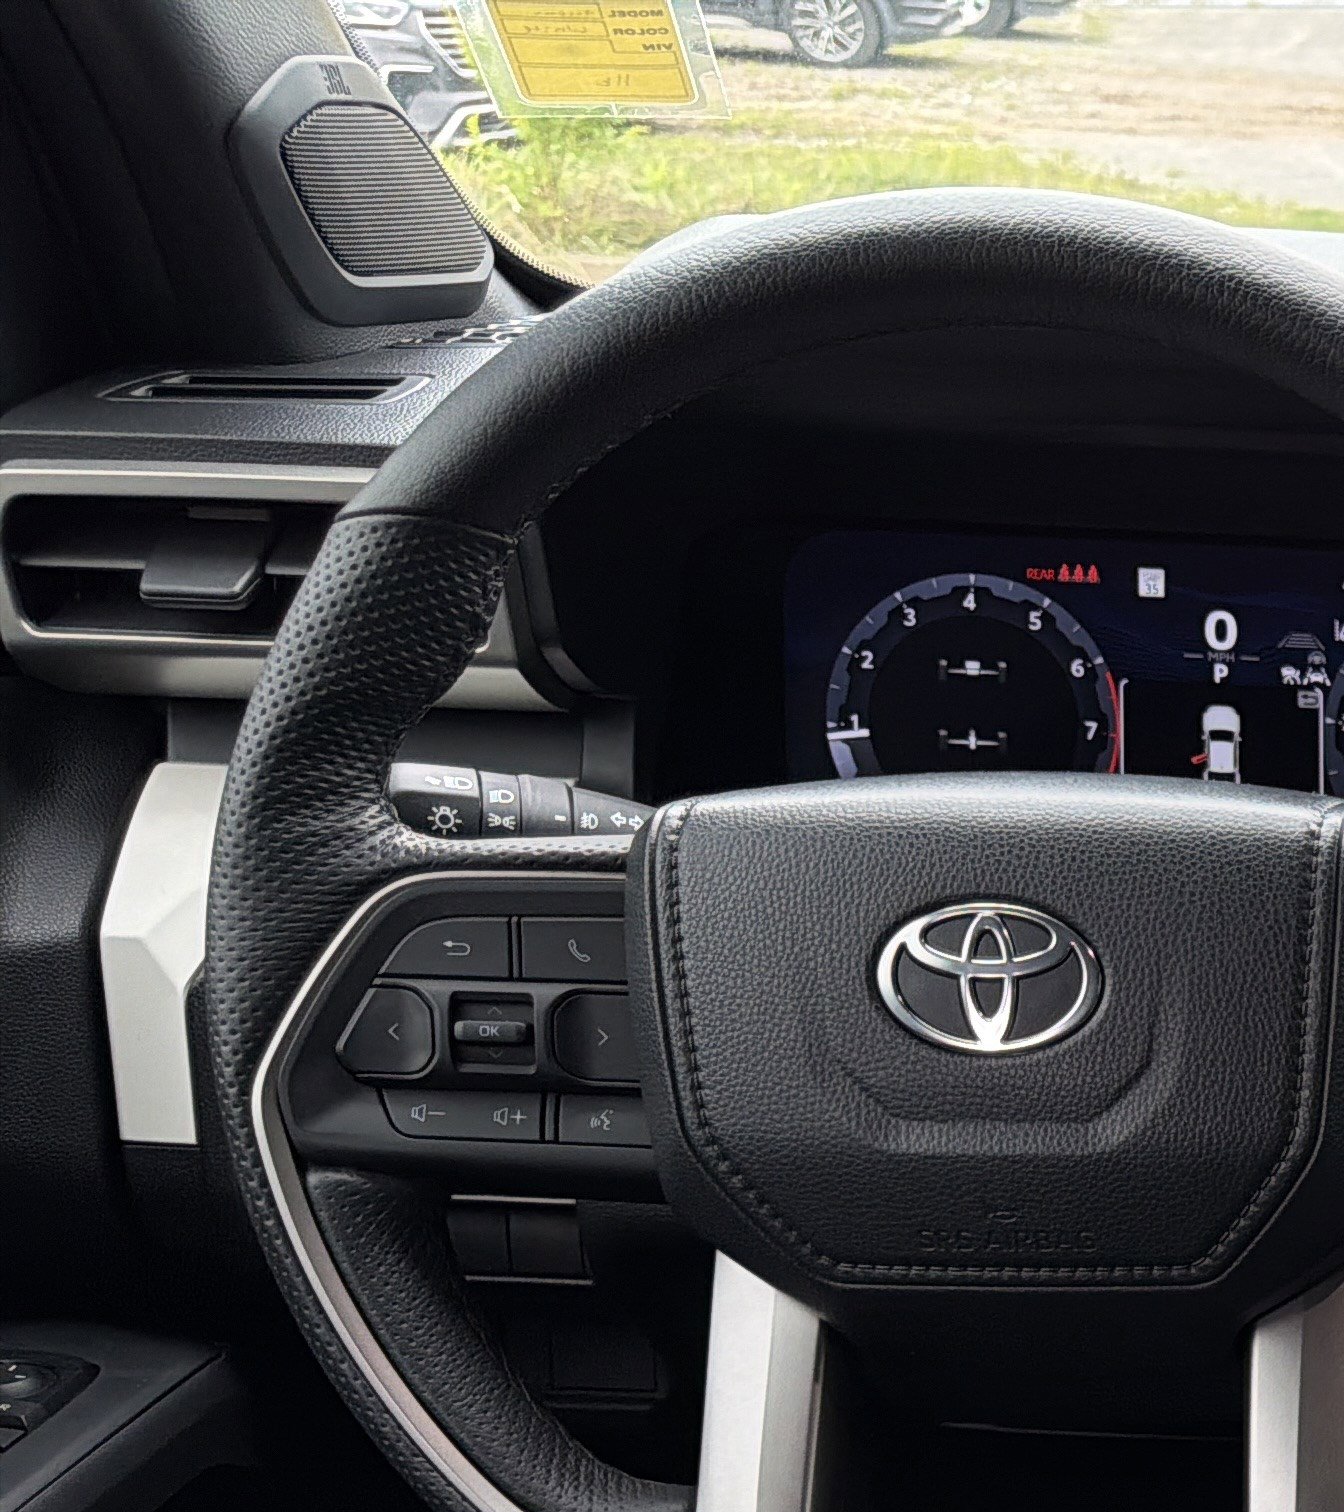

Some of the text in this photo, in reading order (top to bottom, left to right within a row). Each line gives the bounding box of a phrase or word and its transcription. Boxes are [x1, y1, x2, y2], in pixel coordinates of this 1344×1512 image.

[1026, 568, 1055, 580] REAR
[1145, 582, 1160, 595] 35
[962, 592, 976, 611] 4
[902, 608, 917, 627] 3
[1028, 611, 1042, 631] 5
[1204, 609, 1238, 651] 0
[860, 650, 875, 670] 2
[1206, 651, 1236, 663] MPH
[1070, 658, 1085, 678] 6
[1213, 662, 1229, 684] P
[850, 714, 859, 730] 1
[1084, 721, 1099, 740] 7
[478, 1024, 500, 1037] OK
